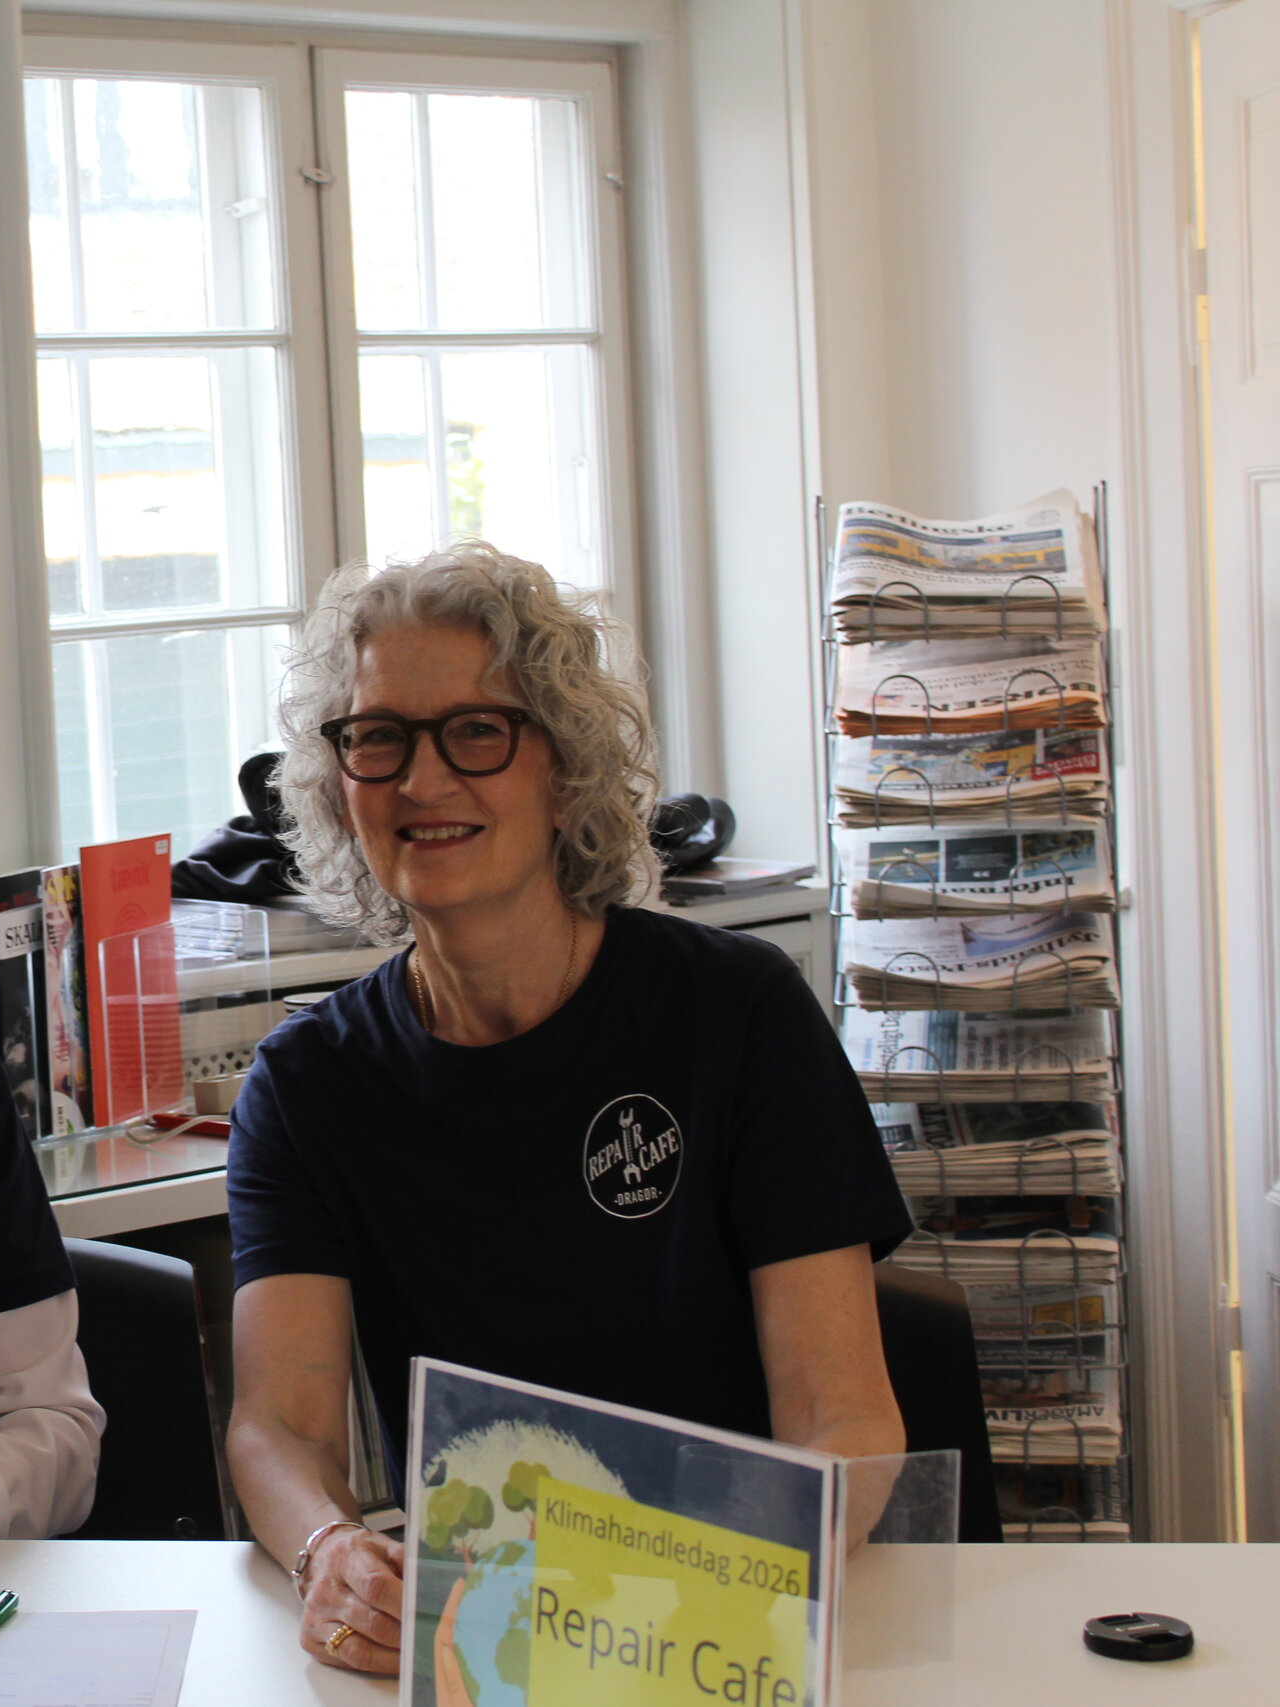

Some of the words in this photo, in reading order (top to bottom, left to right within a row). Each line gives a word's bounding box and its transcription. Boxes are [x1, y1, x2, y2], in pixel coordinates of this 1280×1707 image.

[936, 876, 1074, 895] Informat
[883, 931, 1100, 974] Jyllands-Poste
[639, 1127, 679, 1171] CAFE
[545, 1497, 731, 1587] Klimahandledag
[738, 1554, 802, 1597] 2026
[536, 1586, 677, 1679] Repair
[692, 1639, 797, 1707] Cafe
